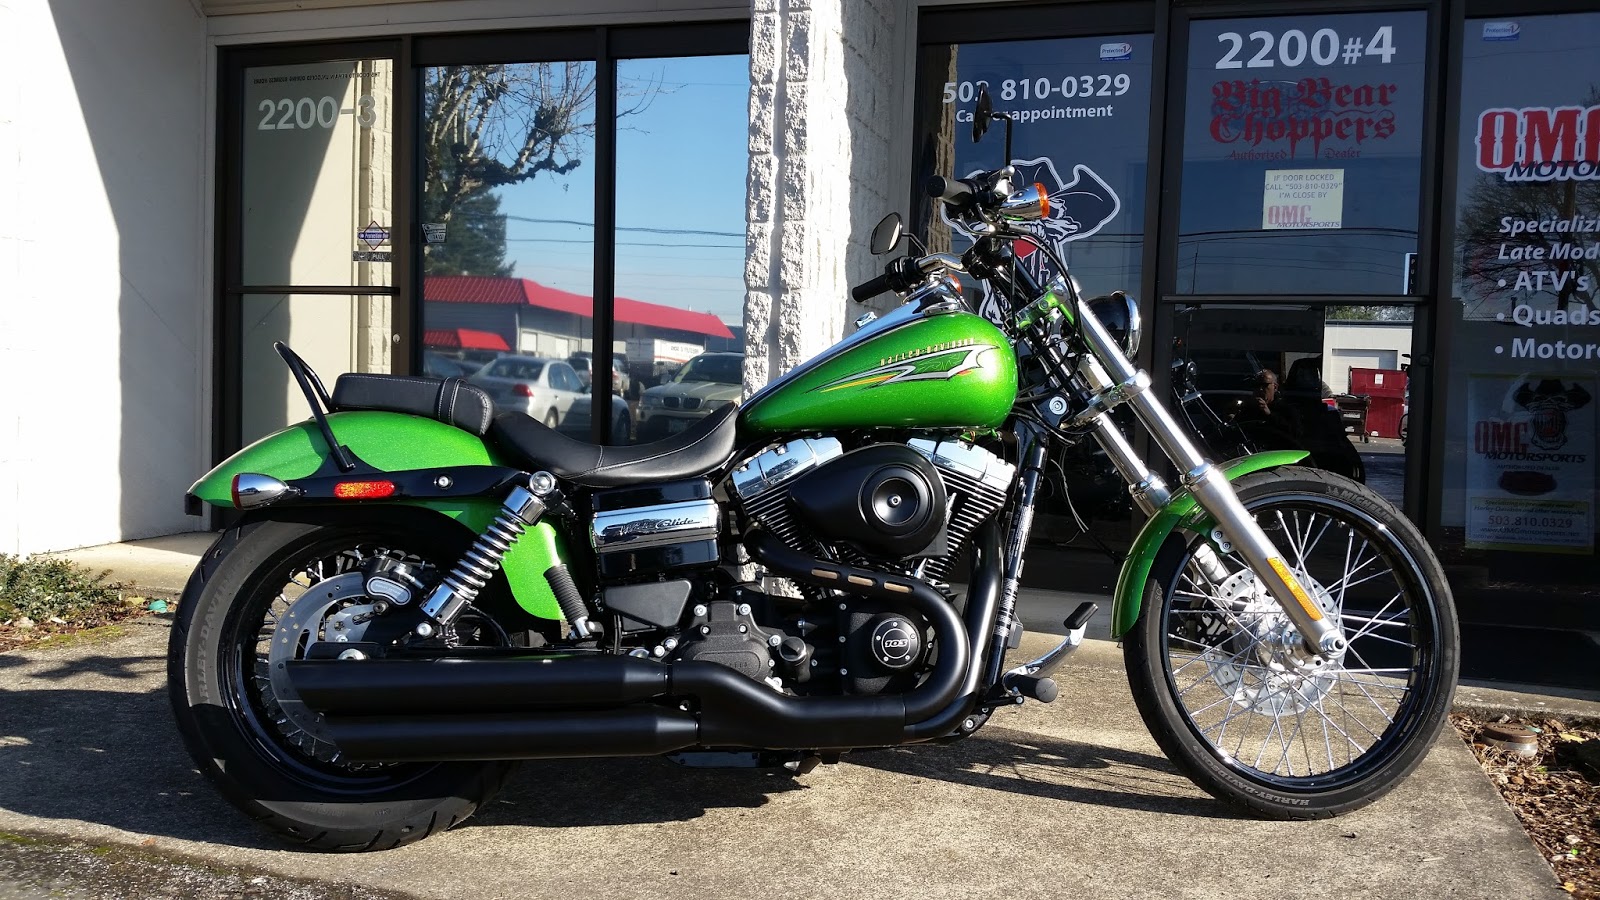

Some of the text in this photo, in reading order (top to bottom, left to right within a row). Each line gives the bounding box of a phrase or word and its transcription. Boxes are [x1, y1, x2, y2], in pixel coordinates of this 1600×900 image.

[1215, 25, 1396, 70] 2200#4
[1000, 73, 1131, 101] 810-0329
[1211, 77, 1398, 117] Big Bear
[257, 94, 377, 131] 2200-3
[1011, 104, 1114, 123] appointment
[1209, 108, 1396, 160] Choppers
[1224, 148, 1361, 161] Authorized Dealer
[1265, 183, 1283, 191] CALL
[1283, 174, 1304, 182] DOOR
[1306, 173, 1335, 181] LOCKED
[1268, 205, 1313, 225] OMG
[1498, 242, 1600, 260] Late Mod
[1514, 270, 1589, 292] ATV's
[1512, 304, 1600, 328] Quads
[1511, 337, 1600, 360] Motor
[1475, 420, 1530, 454] OMG
[1485, 452, 1588, 463] MOTORSPORTS
[1340, 488, 1395, 523] MICHELIN
[1488, 515, 1573, 528] 503.810.0329
[884, 638, 908, 648] 103
